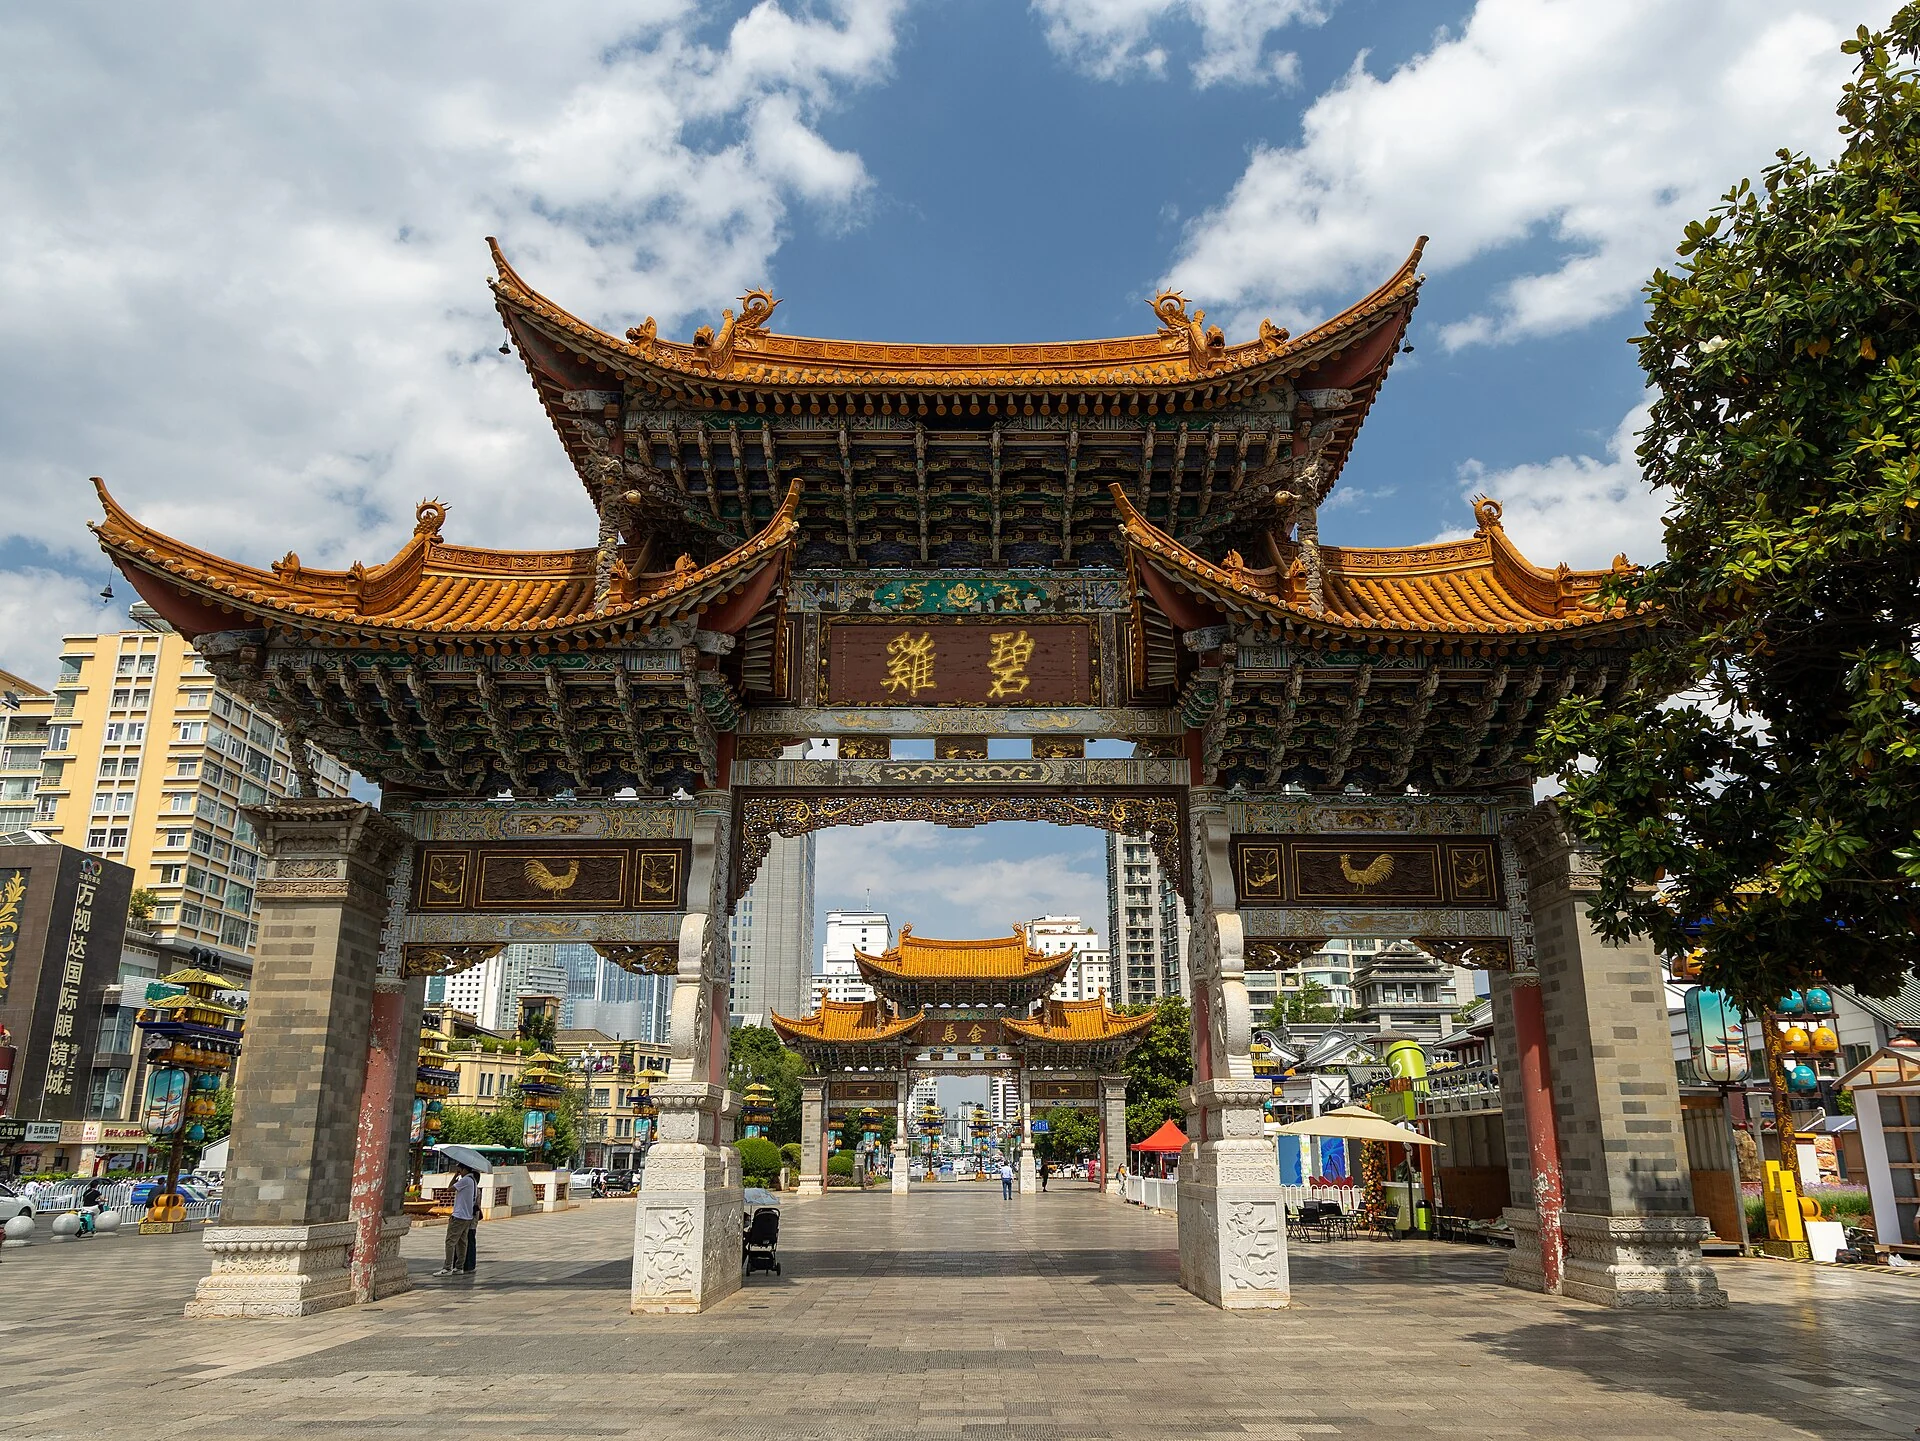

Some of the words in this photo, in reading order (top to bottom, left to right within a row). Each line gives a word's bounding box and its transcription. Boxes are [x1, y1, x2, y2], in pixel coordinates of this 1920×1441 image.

[46, 883, 96, 1095] 万视达国际眼镜城
[0, 1126, 25, 1136] 小粒咖啡
